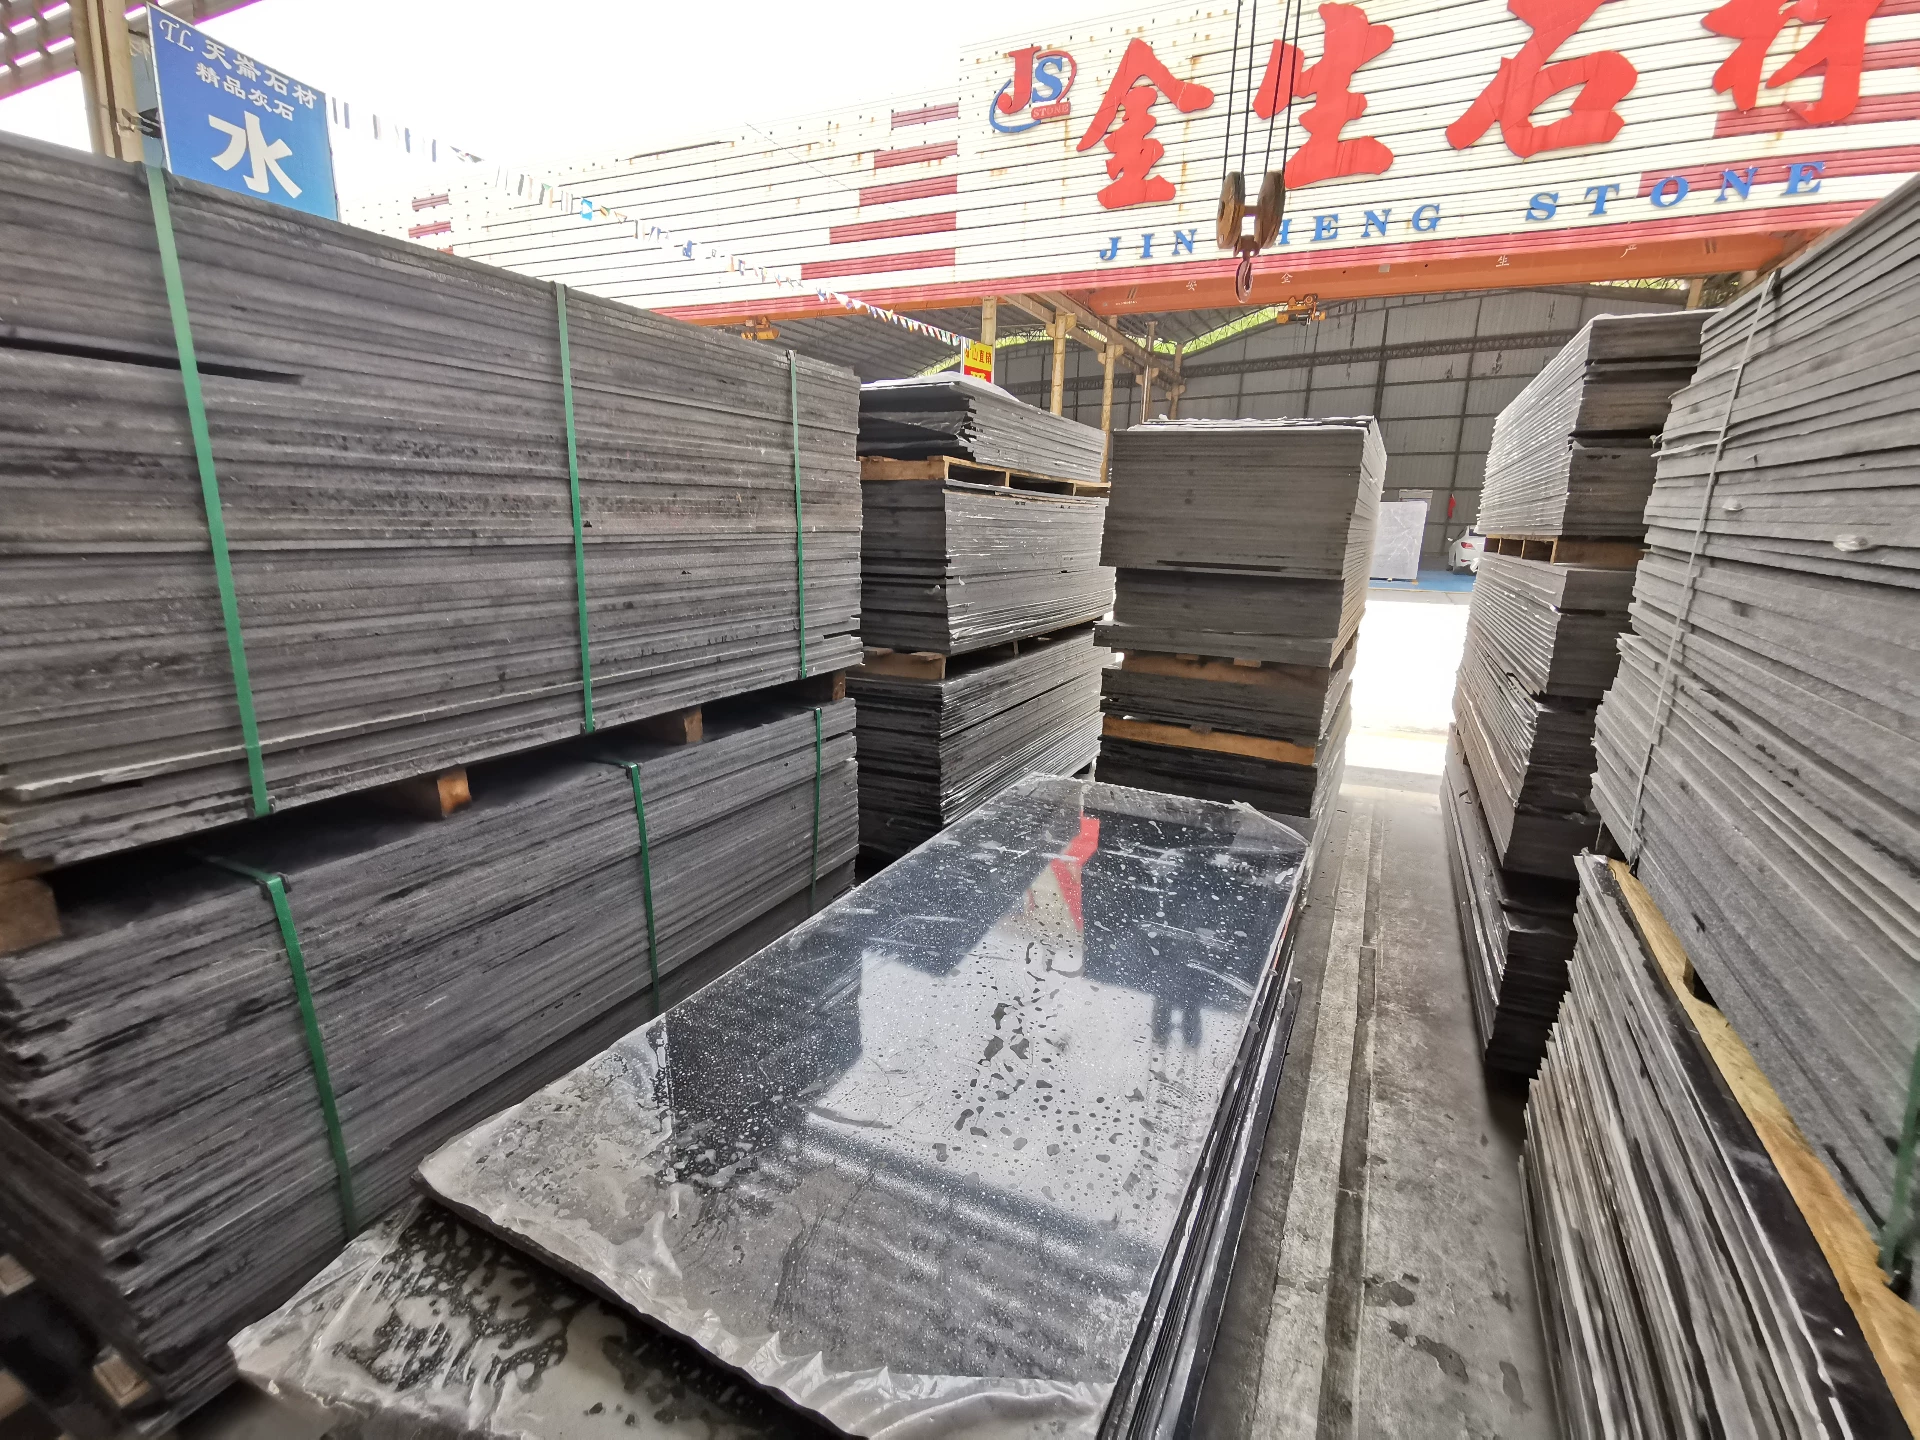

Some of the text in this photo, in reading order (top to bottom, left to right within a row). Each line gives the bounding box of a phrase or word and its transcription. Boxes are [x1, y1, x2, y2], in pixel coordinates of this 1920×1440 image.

[159, 19, 194, 52] TL
[195, 62, 295, 122] 精品灰石
[997, 46, 1063, 114] JS
[1032, 104, 1069, 118] STONE
[208, 110, 303, 199] 水
[1099, 161, 1826, 261] JINHENG STONE
